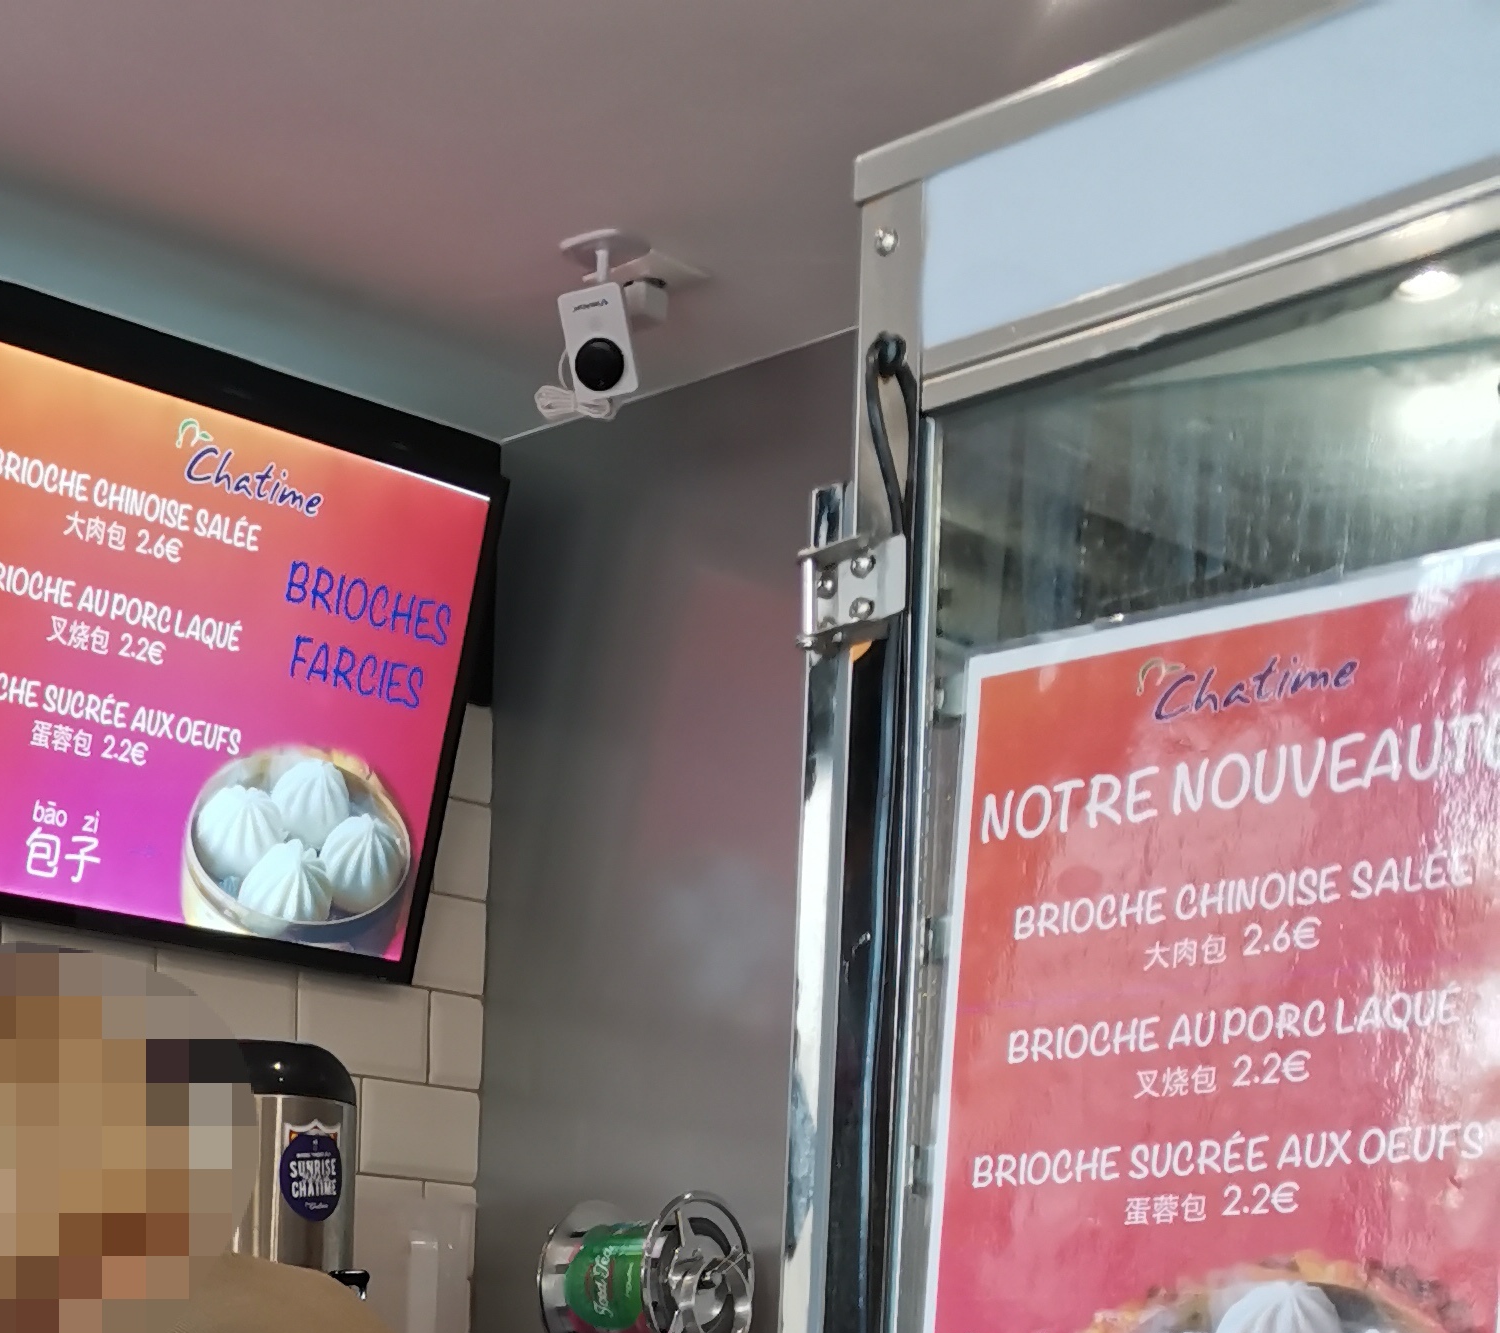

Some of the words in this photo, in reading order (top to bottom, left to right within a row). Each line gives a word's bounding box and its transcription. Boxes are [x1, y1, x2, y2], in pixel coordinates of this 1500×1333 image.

[92, 478, 193, 531] CHINOISE
[193, 508, 262, 552] SALÉE
[184, 446, 323, 517] Chatime
[63, 510, 127, 552] 大肉包
[135, 528, 184, 564] 2.6€
[77, 585, 110, 616] AU
[109, 592, 172, 634] PORC
[173, 608, 243, 652] LAQUÉ
[285, 560, 451, 647] BRIOCHES
[46, 615, 110, 655] 叉烧包
[118, 632, 167, 666] 2.2€
[289, 634, 424, 709] FARCIES
[42, 684, 130, 728] SUCRÉE
[130, 706, 175, 740] AUX
[175, 716, 242, 756] OEUFS
[1154, 656, 1360, 723] Chatime
[29, 719, 93, 757] 蛋蓉包
[100, 734, 149, 767] 2.2€
[31, 800, 68, 828] bāo
[980, 764, 1161, 845] NOTRE
[25, 826, 102, 883] 包子
[1013, 886, 1167, 941] BRIOCHE
[1175, 865, 1342, 921] CHINOISE
[1350, 845, 1475, 900] SALÉE
[1143, 936, 1227, 972] 大肉包
[1242, 916, 1322, 957] 2.6€
[1006, 1016, 1161, 1065] BRIOCHE
[1167, 1009, 1217, 1052] AU
[1221, 998, 1327, 1046] PORC
[1335, 985, 1462, 1035] LAQUÉ
[1133, 1065, 1217, 1100] 叉烧包
[1232, 1050, 1312, 1089] 2.2€
[289, 1158, 337, 1179] SUNRISE
[291, 1178, 337, 1199] CHATIME
[971, 1144, 1121, 1190] BRIOCHE
[1128, 1129, 1267, 1180] SUCRÉE
[1277, 1128, 1353, 1170] AUX
[1358, 1121, 1485, 1165] OEUFS
[1123, 1195, 1207, 1226] 蛋蓉包
[1221, 1182, 1301, 1218] 2.2€
